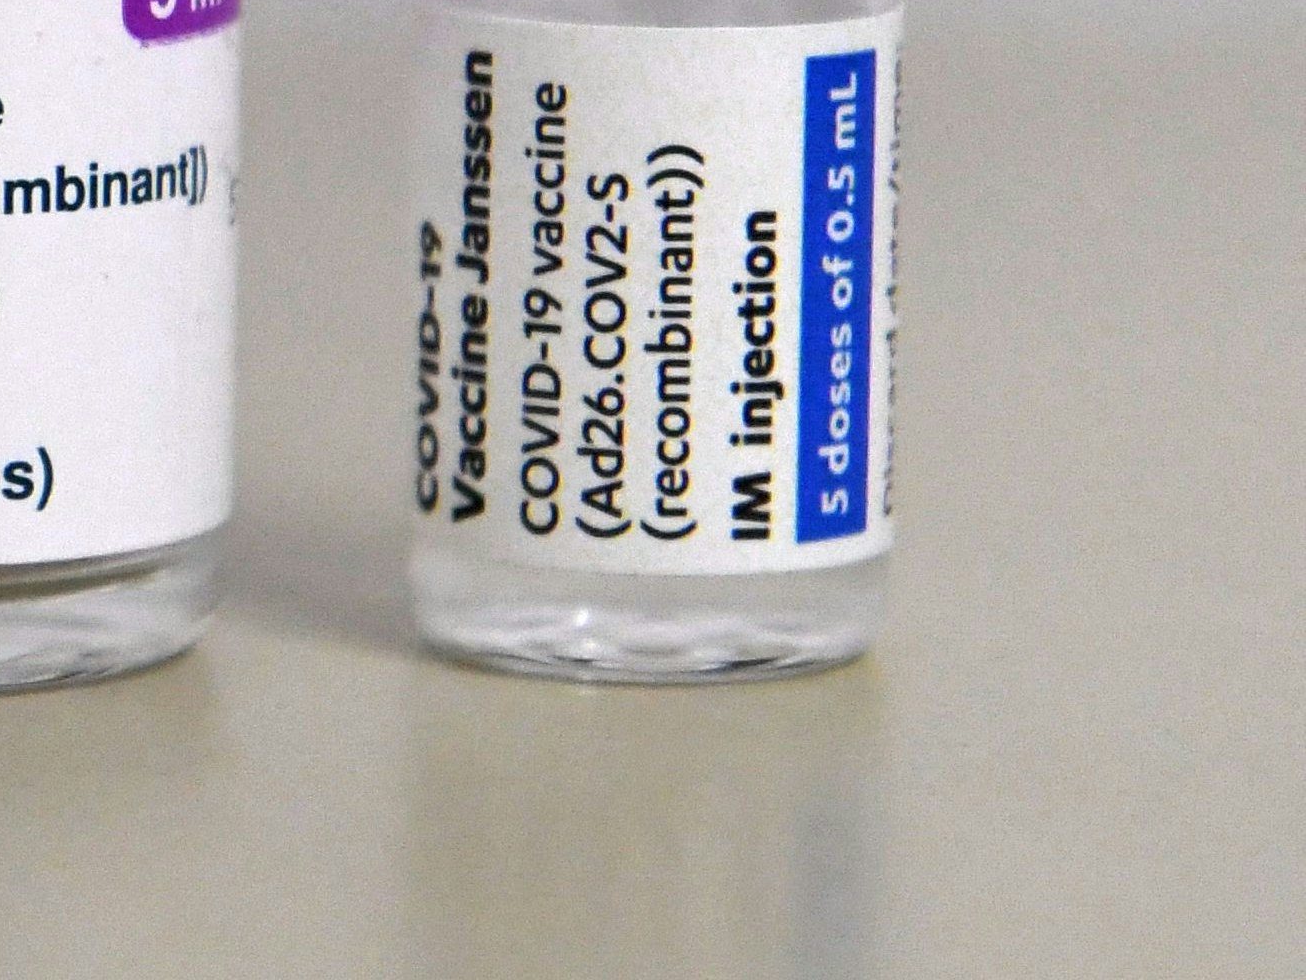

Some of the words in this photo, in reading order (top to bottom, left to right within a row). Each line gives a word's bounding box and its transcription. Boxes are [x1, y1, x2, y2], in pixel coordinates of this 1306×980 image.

[456, 50, 495, 282] Janssen
[526, 81, 569, 276] vaccine
[827, 164, 857, 242] 0.5
[831, 73, 858, 150] mL
[416, 220, 443, 512] COVID-19
[575, 172, 629, 541] (Ad26.COV2-S
[640, 144, 705, 542] (recombinant))
[730, 210, 785, 447] injection
[822, 256, 855, 310] of
[451, 293, 489, 522] Vaccine
[519, 286, 567, 535] COVID-19
[820, 323, 852, 471] doses
[821, 488, 849, 516] 5
[731, 470, 773, 541] IM
